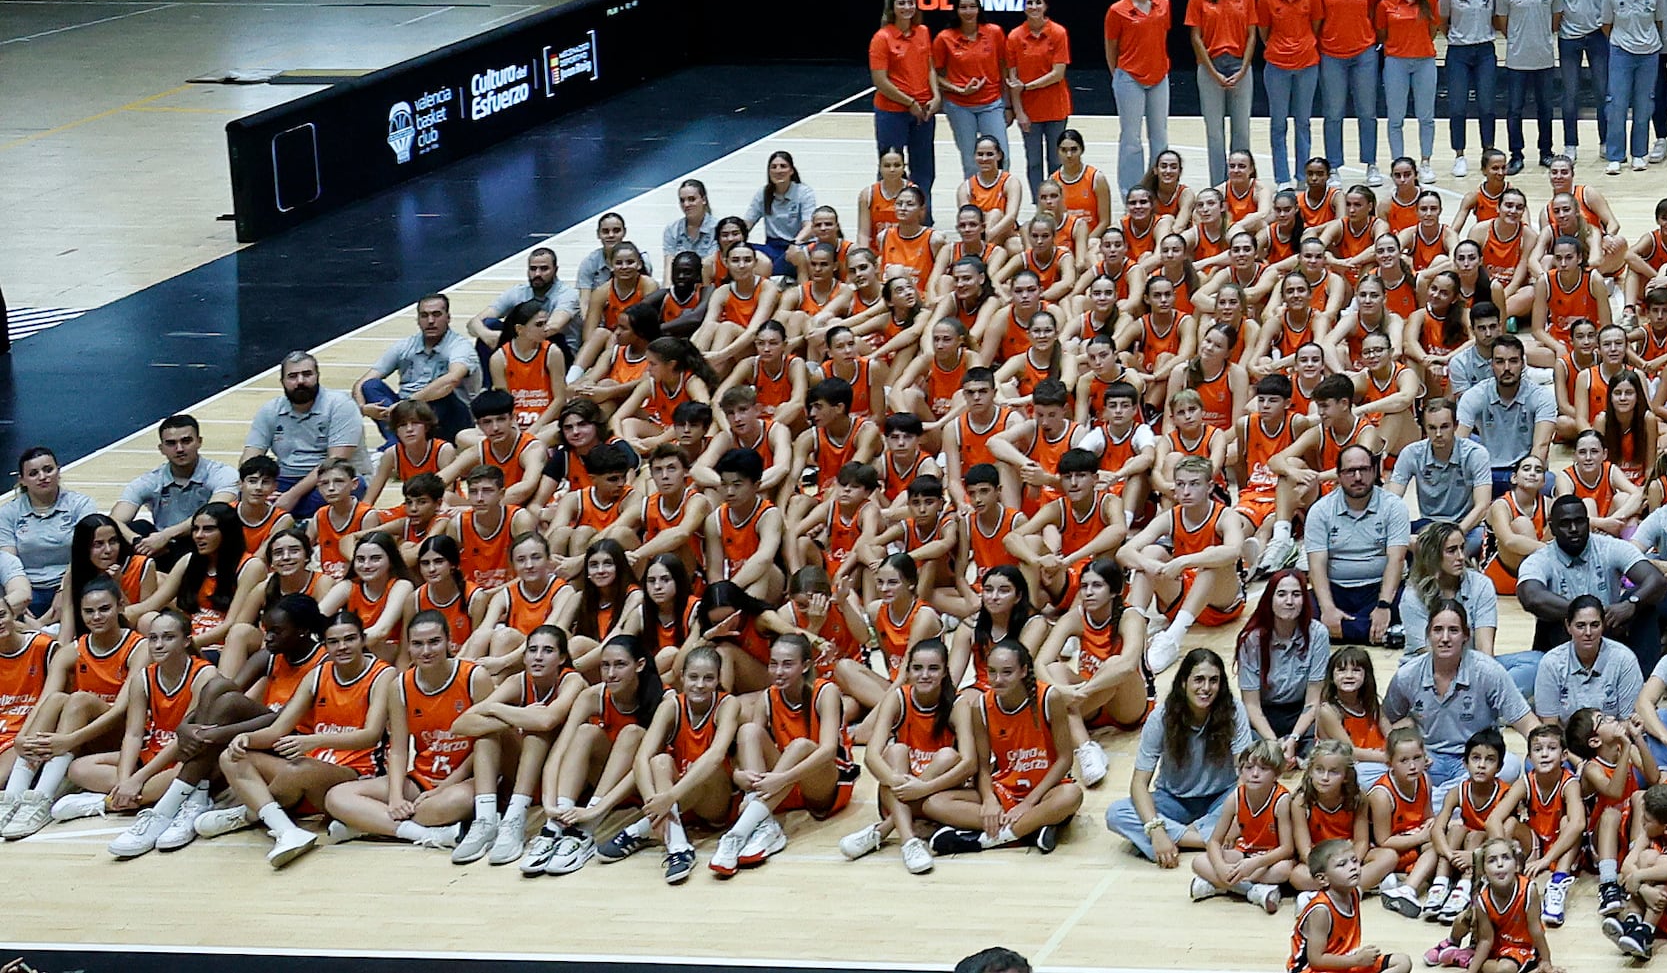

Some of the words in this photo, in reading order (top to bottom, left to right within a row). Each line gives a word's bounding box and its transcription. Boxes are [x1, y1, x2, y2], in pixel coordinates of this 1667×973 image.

[471, 65, 517, 97] Cultura
[414, 86, 453, 111] valencia
[471, 83, 529, 121] Esfuerzo
[415, 107, 447, 130] basket
[417, 127, 439, 147] club
